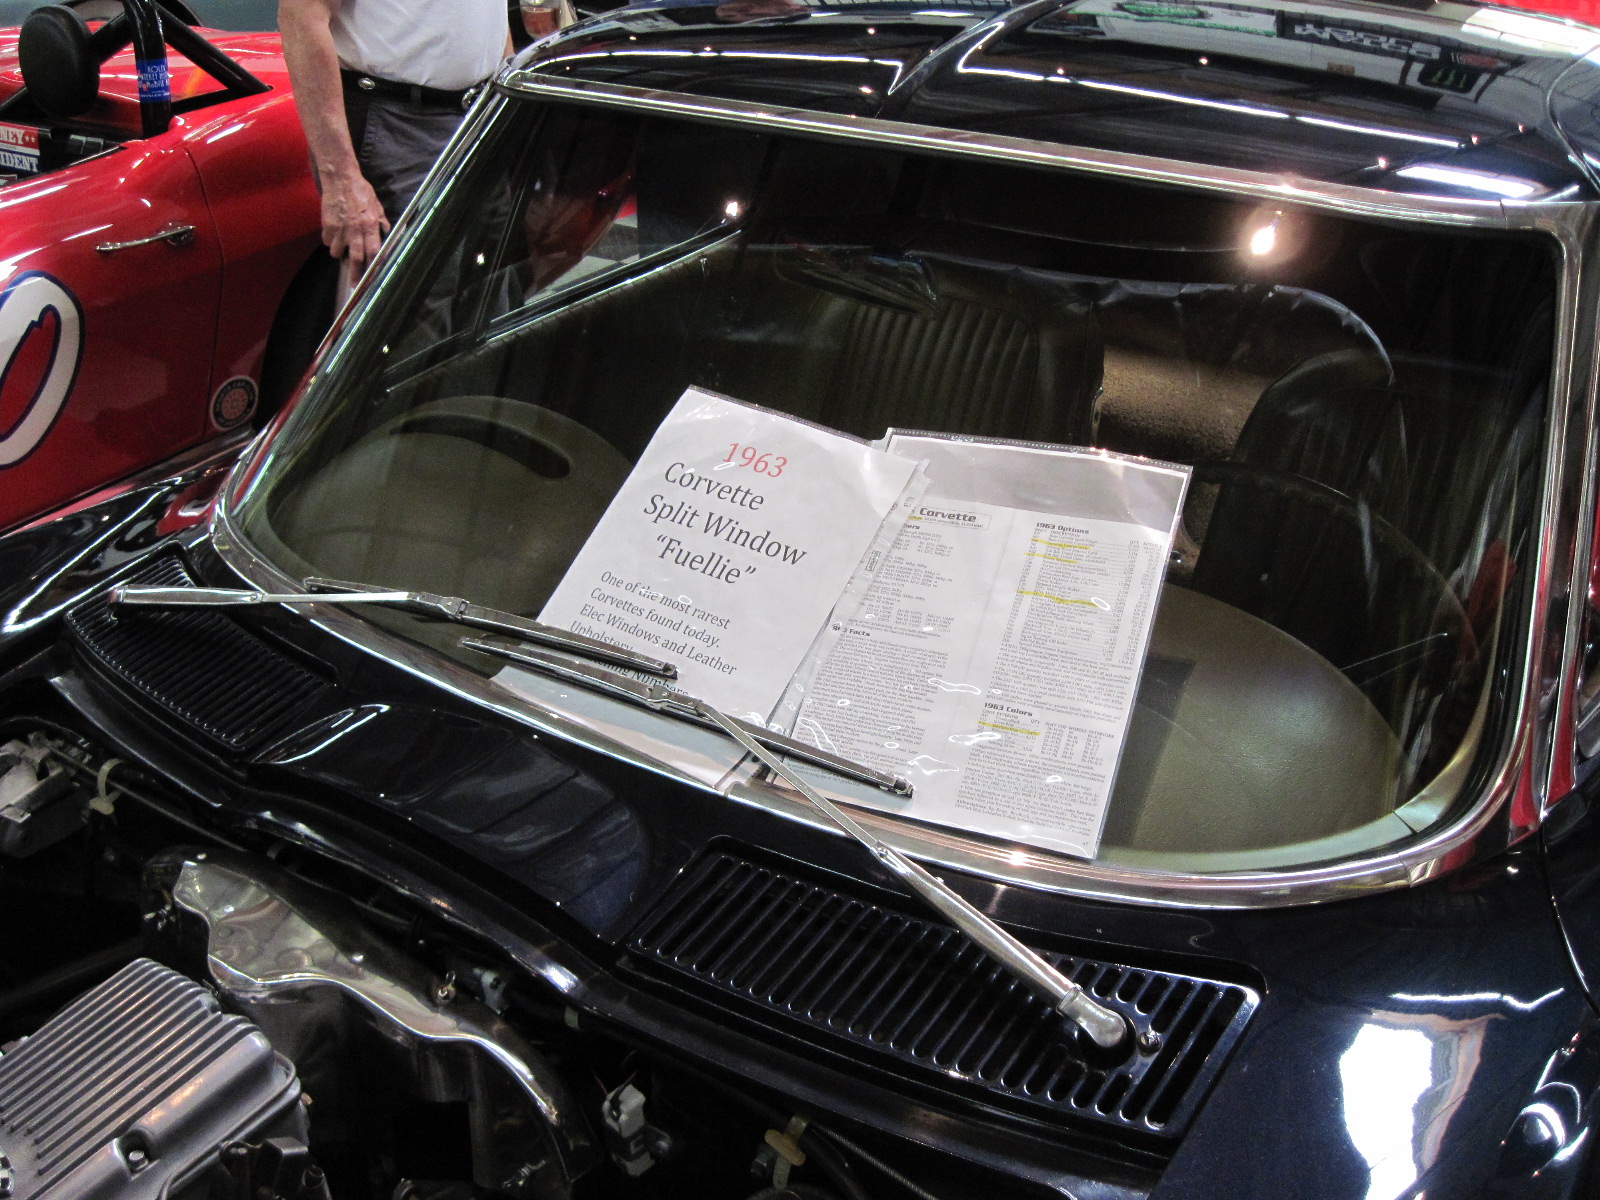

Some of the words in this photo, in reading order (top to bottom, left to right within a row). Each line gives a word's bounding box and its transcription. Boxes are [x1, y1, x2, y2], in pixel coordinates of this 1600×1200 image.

[722, 442, 788, 478] 1963
[664, 462, 764, 511] Corvette
[643, 494, 700, 528] Split
[703, 512, 807, 565] Window
[919, 507, 977, 522] Corvette
[1036, 522, 1056, 530] 1963
[1058, 525, 1089, 535] Options
[590, 588, 645, 617] Corvettes
[645, 609, 684, 632] found
[683, 624, 720, 648] today.
[600, 571, 624, 588] One
[625, 582, 641, 594] of
[638, 585, 661, 601] the
[659, 595, 692, 614] most
[691, 607, 732, 629] rarest
[579, 603, 604, 622] Elec
[606, 613, 661, 644] Windows
[661, 638, 687, 655] and
[686, 645, 737, 676] Leather
[985, 702, 1004, 711] 1963
[1006, 706, 1033, 717] Colors
